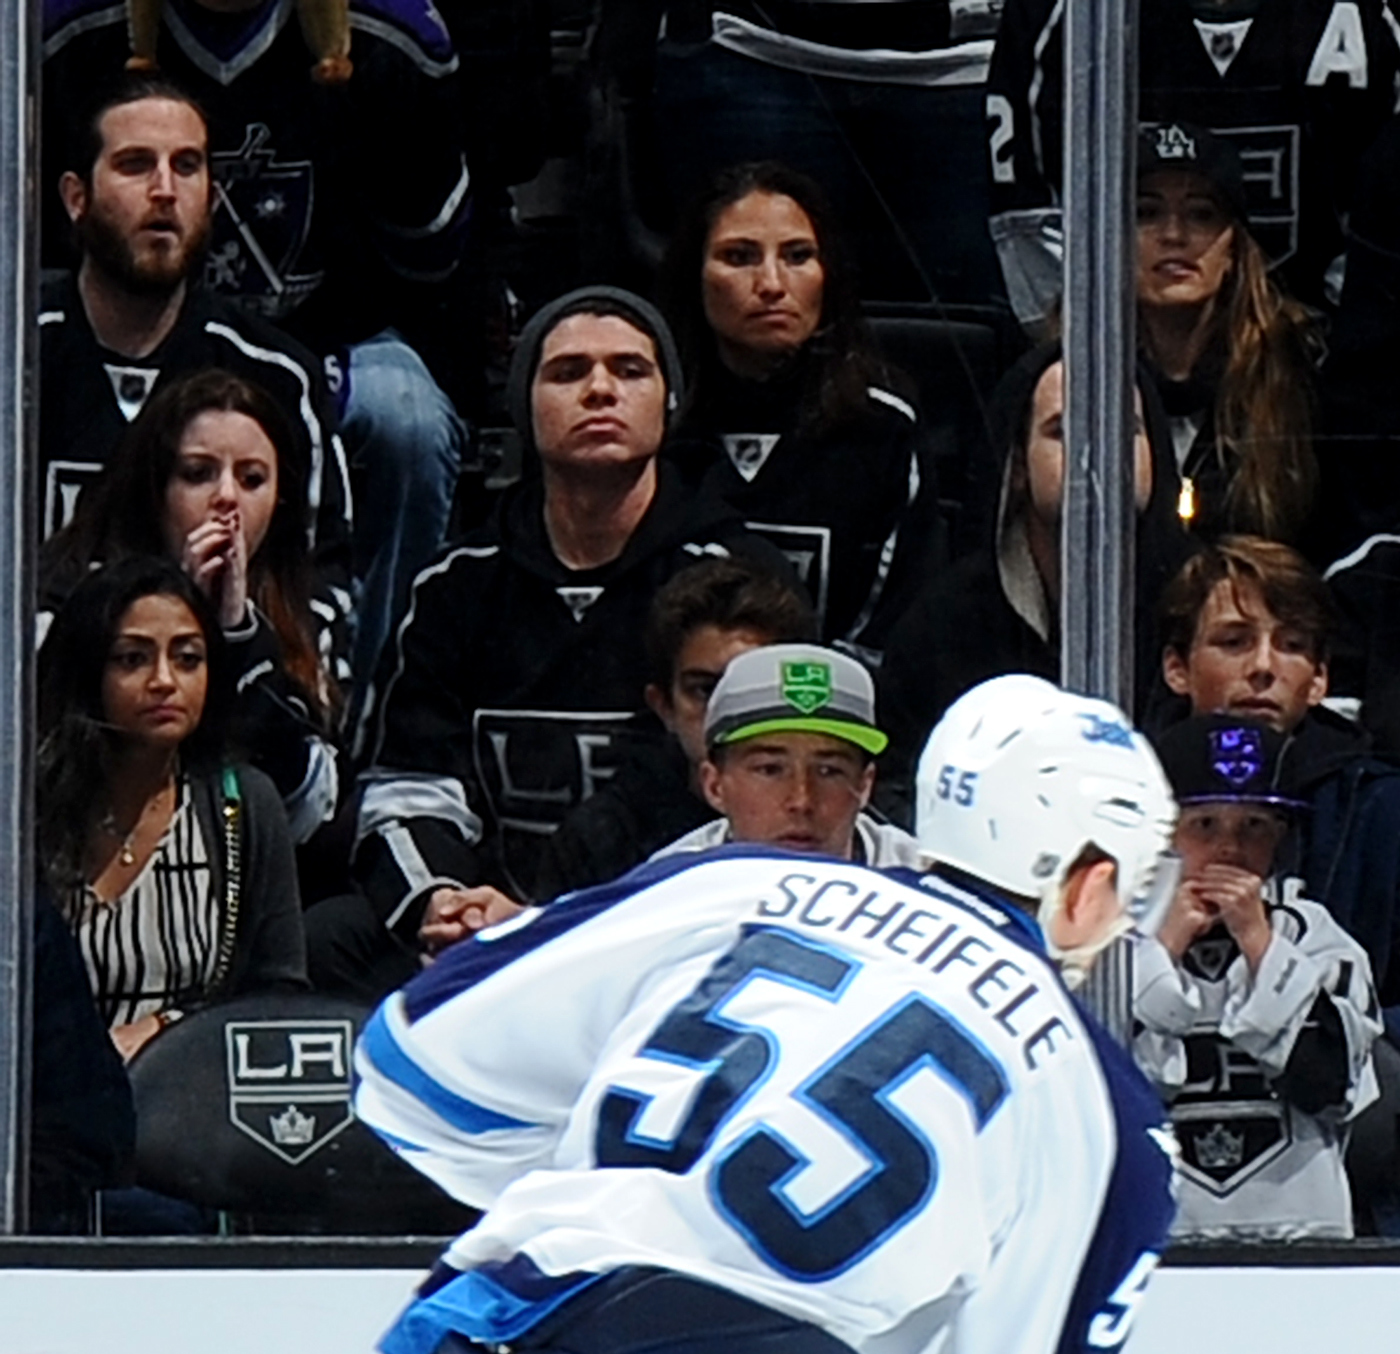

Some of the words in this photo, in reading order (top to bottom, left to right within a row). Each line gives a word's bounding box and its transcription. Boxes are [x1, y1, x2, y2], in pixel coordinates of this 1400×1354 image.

[1305, 2, 1368, 89] A
[936, 765, 978, 807] 55
[757, 873, 1073, 1071] SCHEIFELE
[234, 1031, 345, 1079] LA
[594, 922, 1012, 1284] 55
